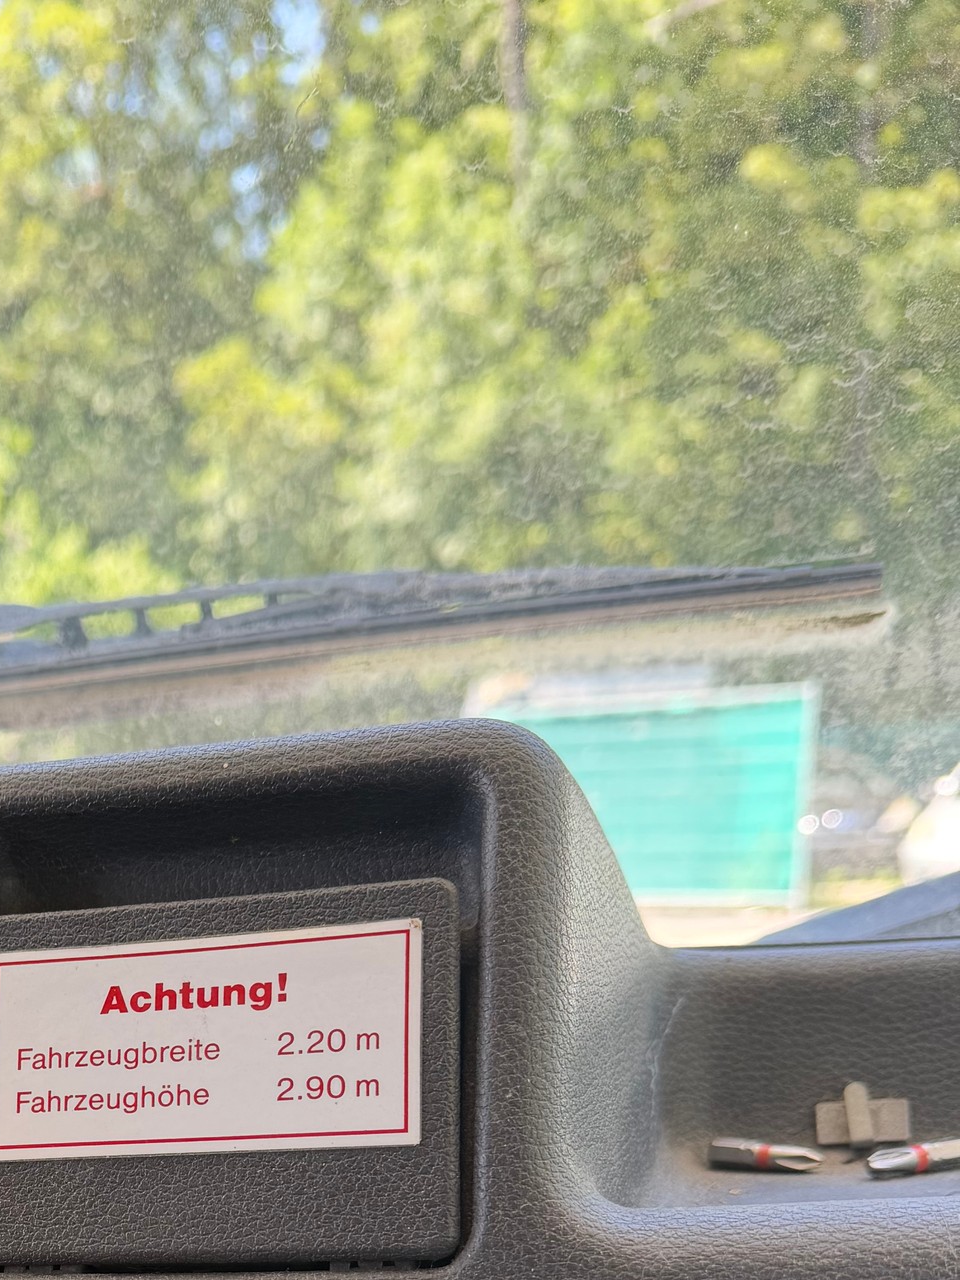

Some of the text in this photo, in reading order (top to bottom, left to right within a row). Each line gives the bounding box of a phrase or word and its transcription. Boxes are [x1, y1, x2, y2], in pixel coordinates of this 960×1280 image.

[100, 972, 288, 1015] Achtung!
[16, 1028, 381, 1071] Fahrzeugbreite 2.20 m
[15, 1074, 381, 1115] Fahrzeughöhe 2.90 m
